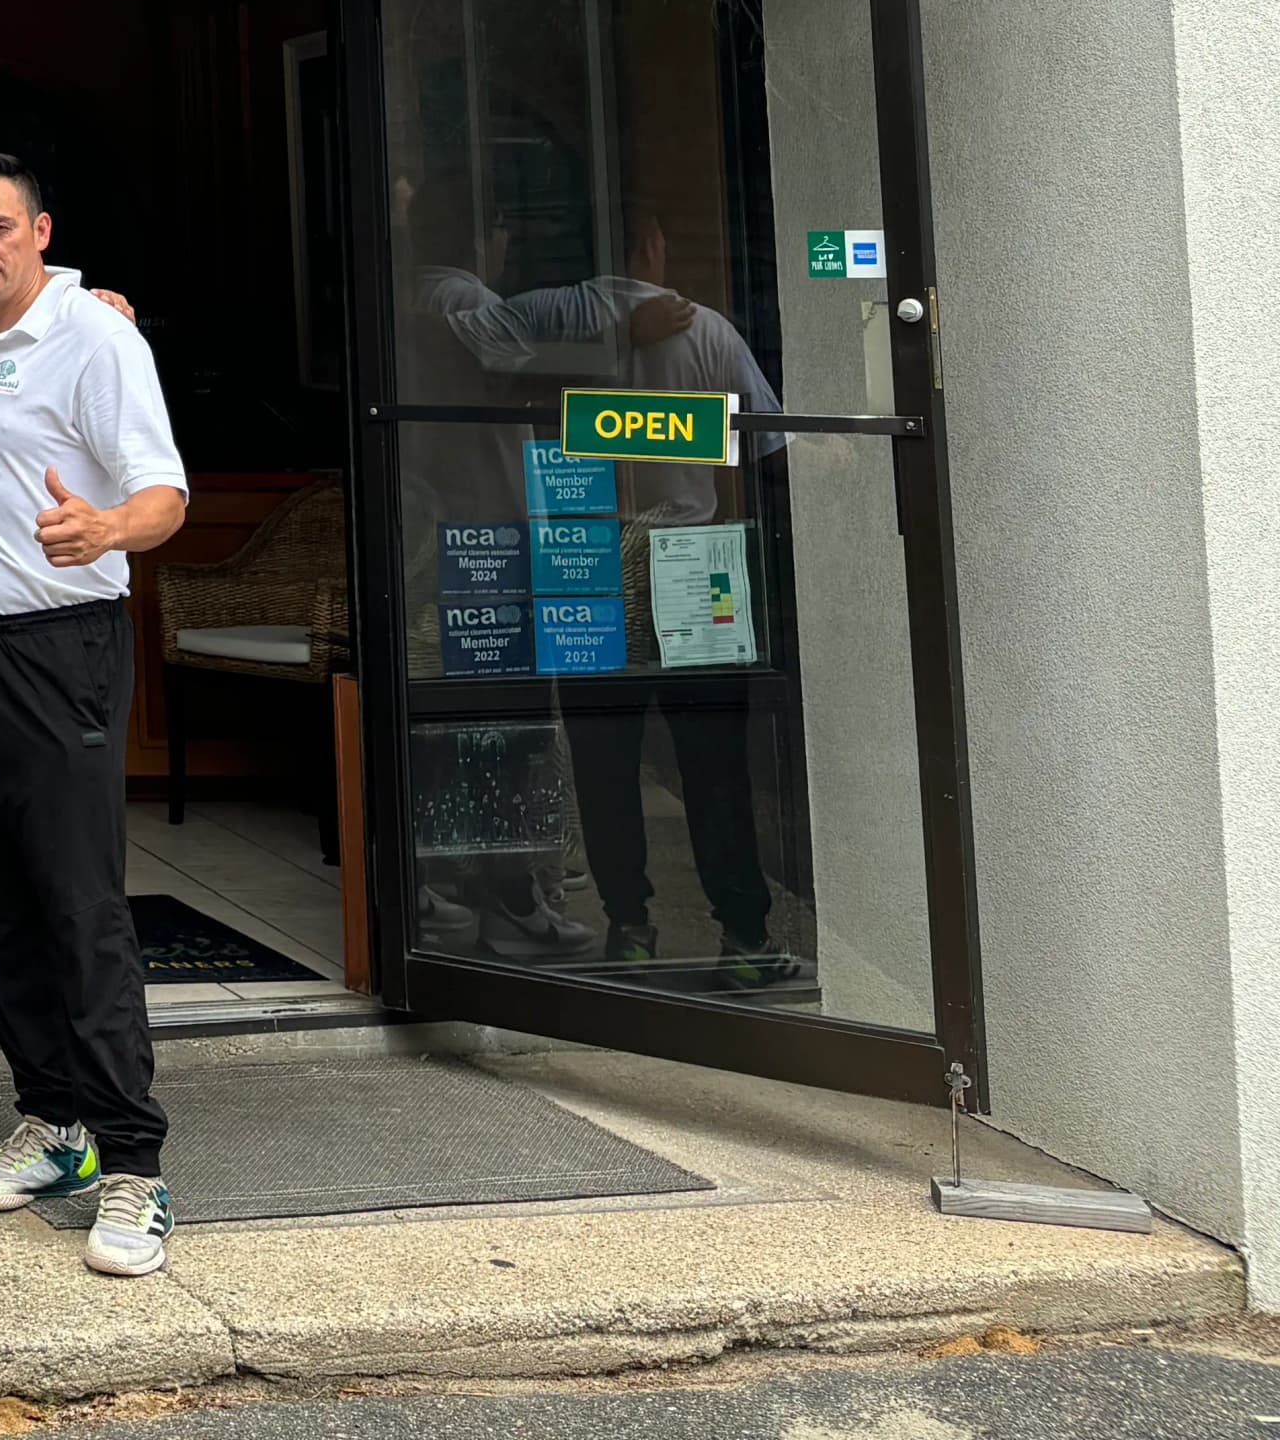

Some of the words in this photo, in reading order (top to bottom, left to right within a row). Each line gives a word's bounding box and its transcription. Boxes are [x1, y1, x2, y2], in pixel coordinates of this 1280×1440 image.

[594, 410, 694, 442] OPEN
[531, 447, 582, 465] nc
[545, 474, 593, 487] Member
[556, 487, 586, 500] 2025
[445, 528, 495, 546] nca
[538, 526, 587, 545] nca
[458, 556, 507, 569] Member
[551, 554, 599, 567] Member
[470, 570, 497, 582] 2024
[562, 568, 590, 580] 2023
[446, 607, 497, 626] nca
[542, 605, 592, 624] nca
[460, 636, 510, 649] Member
[555, 633, 604, 646] Member
[473, 650, 500, 662] 2022
[564, 650, 596, 663] 2021
